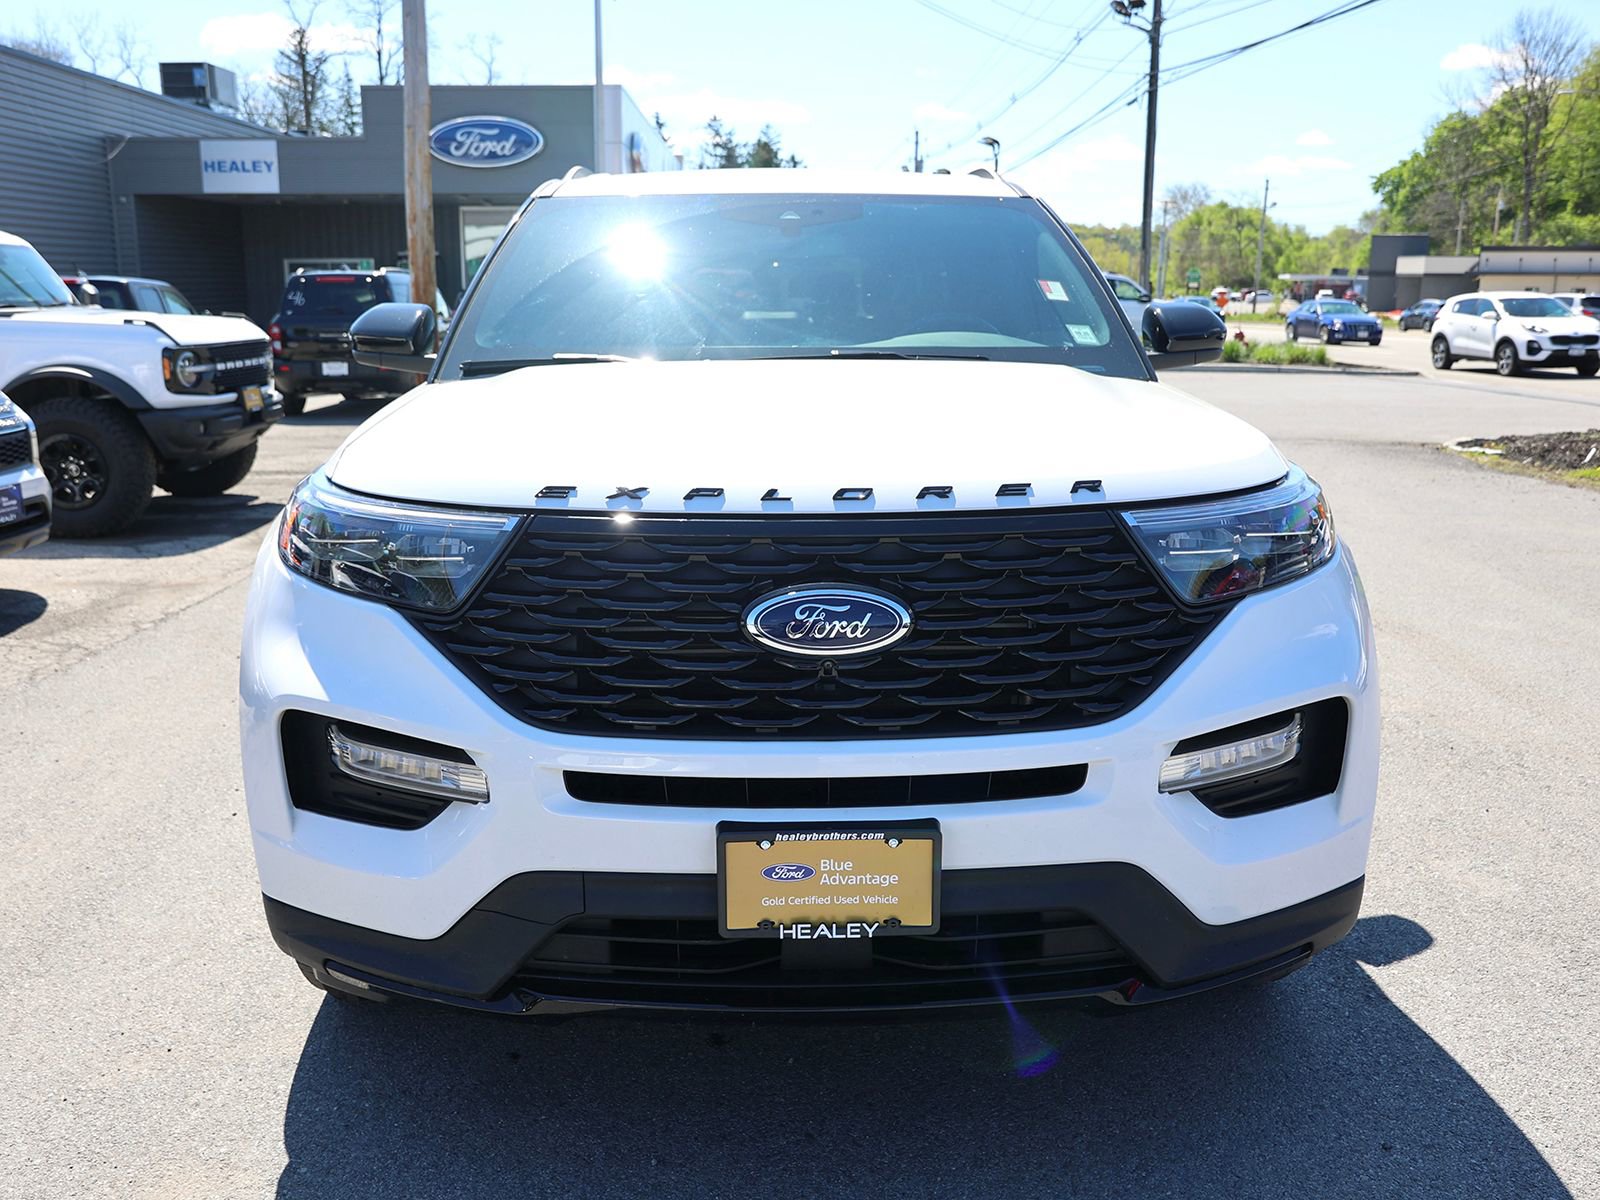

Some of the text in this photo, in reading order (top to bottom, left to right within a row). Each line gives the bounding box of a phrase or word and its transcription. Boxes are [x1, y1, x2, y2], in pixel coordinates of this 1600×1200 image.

[450, 127, 517, 157] Ford
[204, 160, 274, 173] HEALEY
[534, 480, 1103, 501] EXPLORER
[785, 603, 873, 639] Ford
[775, 832, 885, 842] healeybrothers.com
[819, 859, 853, 871] Blue
[771, 865, 806, 880] Ford
[819, 873, 899, 887] Advantage
[761, 895, 899, 906] Gold Certified Used Vehicle
[779, 922, 880, 940] HEALEY
